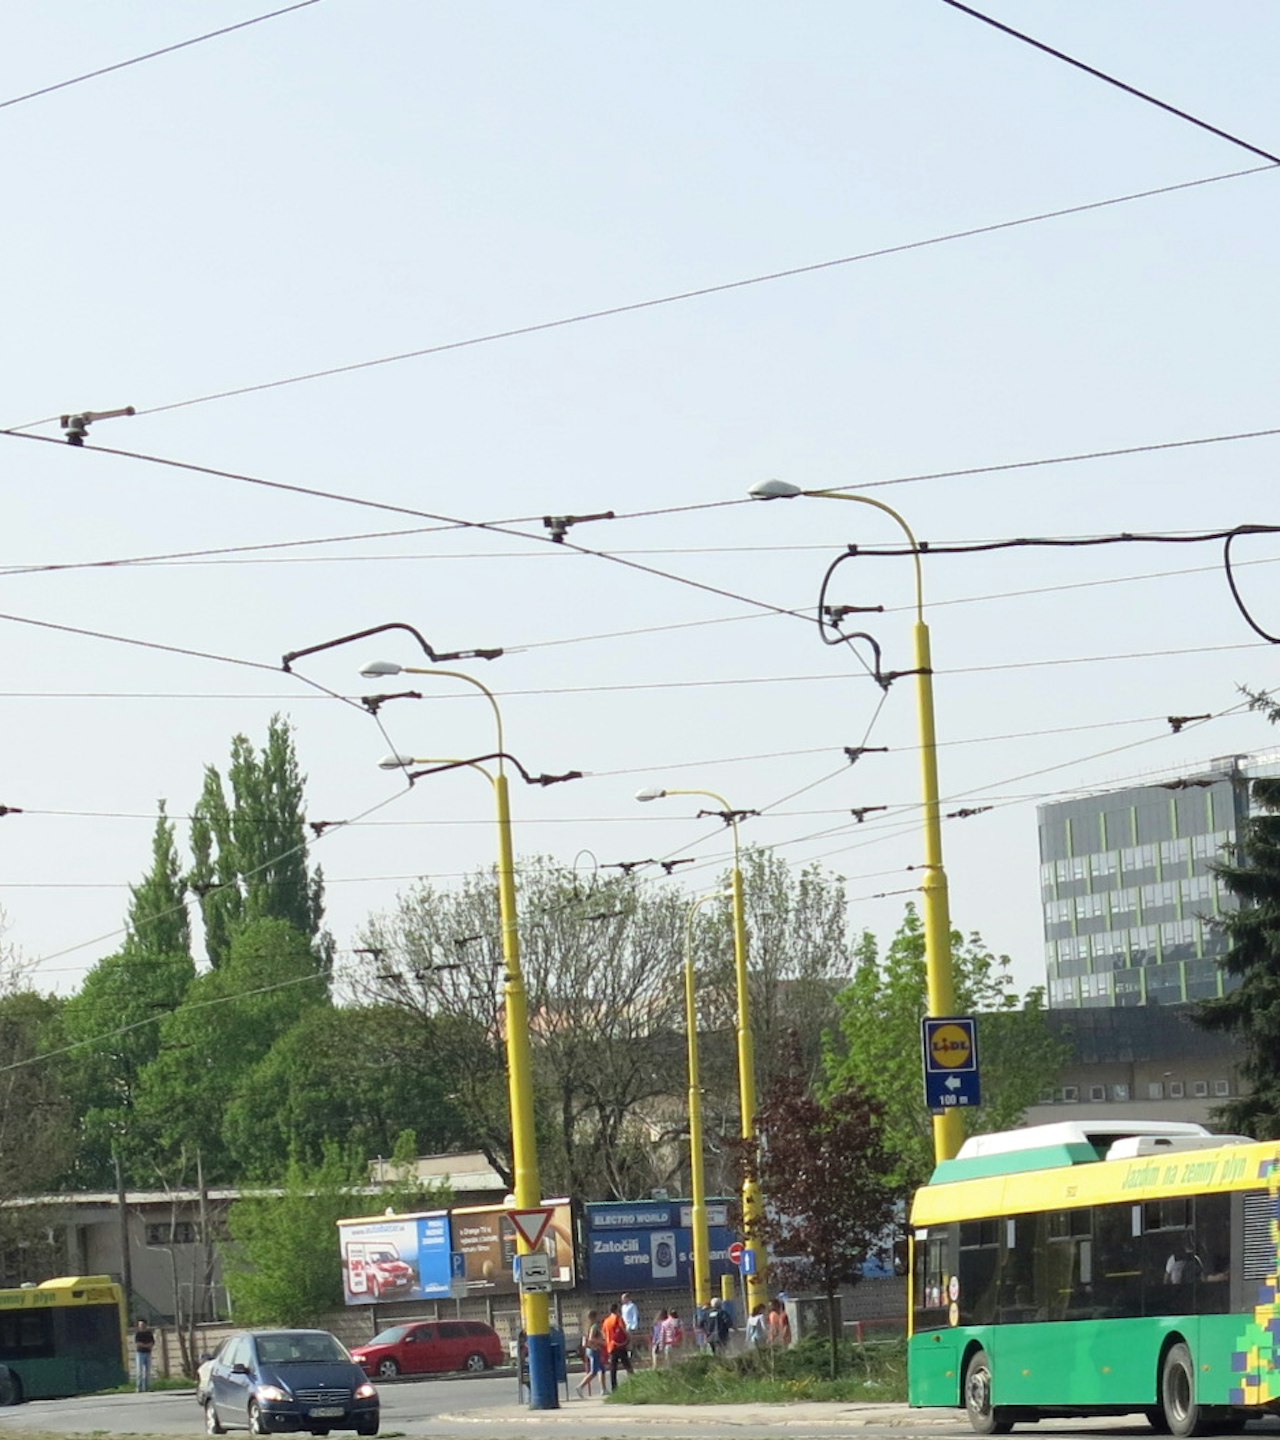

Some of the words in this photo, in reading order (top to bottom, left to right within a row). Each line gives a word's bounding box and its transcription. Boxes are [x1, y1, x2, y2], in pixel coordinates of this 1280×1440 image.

[939, 1094, 957, 1105] 100
[959, 1095, 969, 1104] m
[593, 1214, 636, 1225] ELECTRO
[637, 1213, 669, 1224] WORLD
[593, 1238, 640, 1254] Zatočili
[624, 1254, 650, 1266] sme
